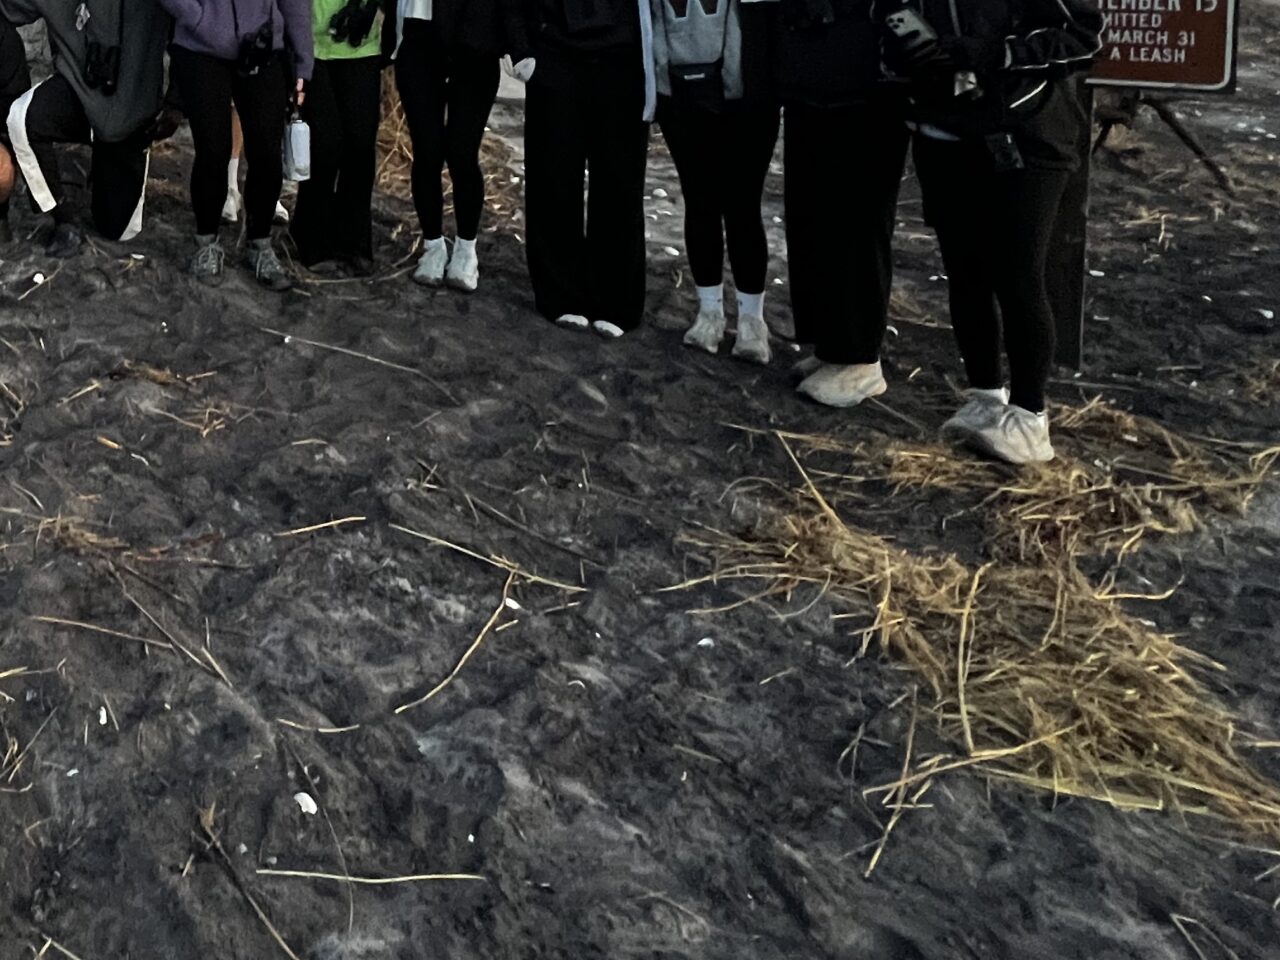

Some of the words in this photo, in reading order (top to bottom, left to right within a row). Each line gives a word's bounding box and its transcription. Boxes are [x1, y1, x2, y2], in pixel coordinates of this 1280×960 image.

[1107, 29, 1169, 46] MARCH
[1177, 31, 1196, 47] 31
[1110, 46, 1121, 61] A
[1129, 47, 1186, 63] LEASH
